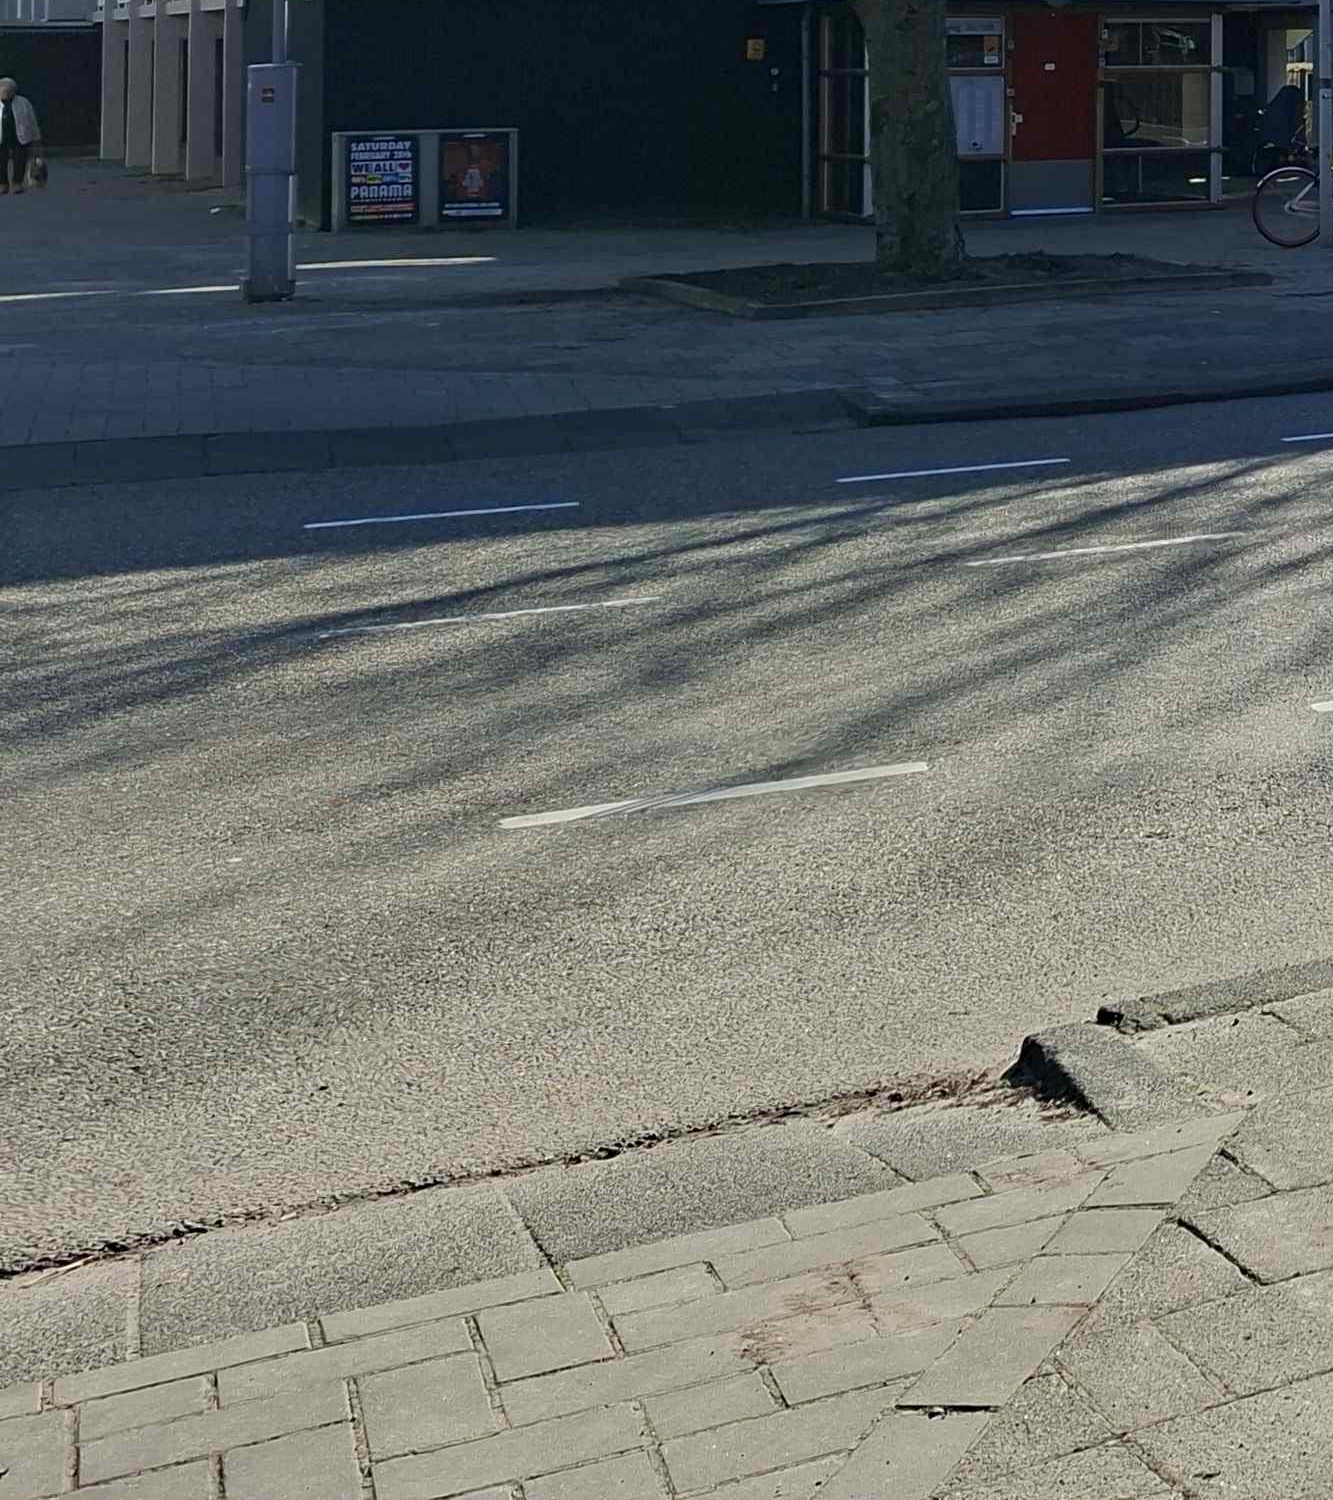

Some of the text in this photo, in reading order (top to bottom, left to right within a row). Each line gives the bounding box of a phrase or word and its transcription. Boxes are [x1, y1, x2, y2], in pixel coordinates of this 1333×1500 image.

[350, 140, 412, 151] SATURDAY
[351, 161, 395, 173] WE ALL
[350, 184, 412, 198] PANAMA
